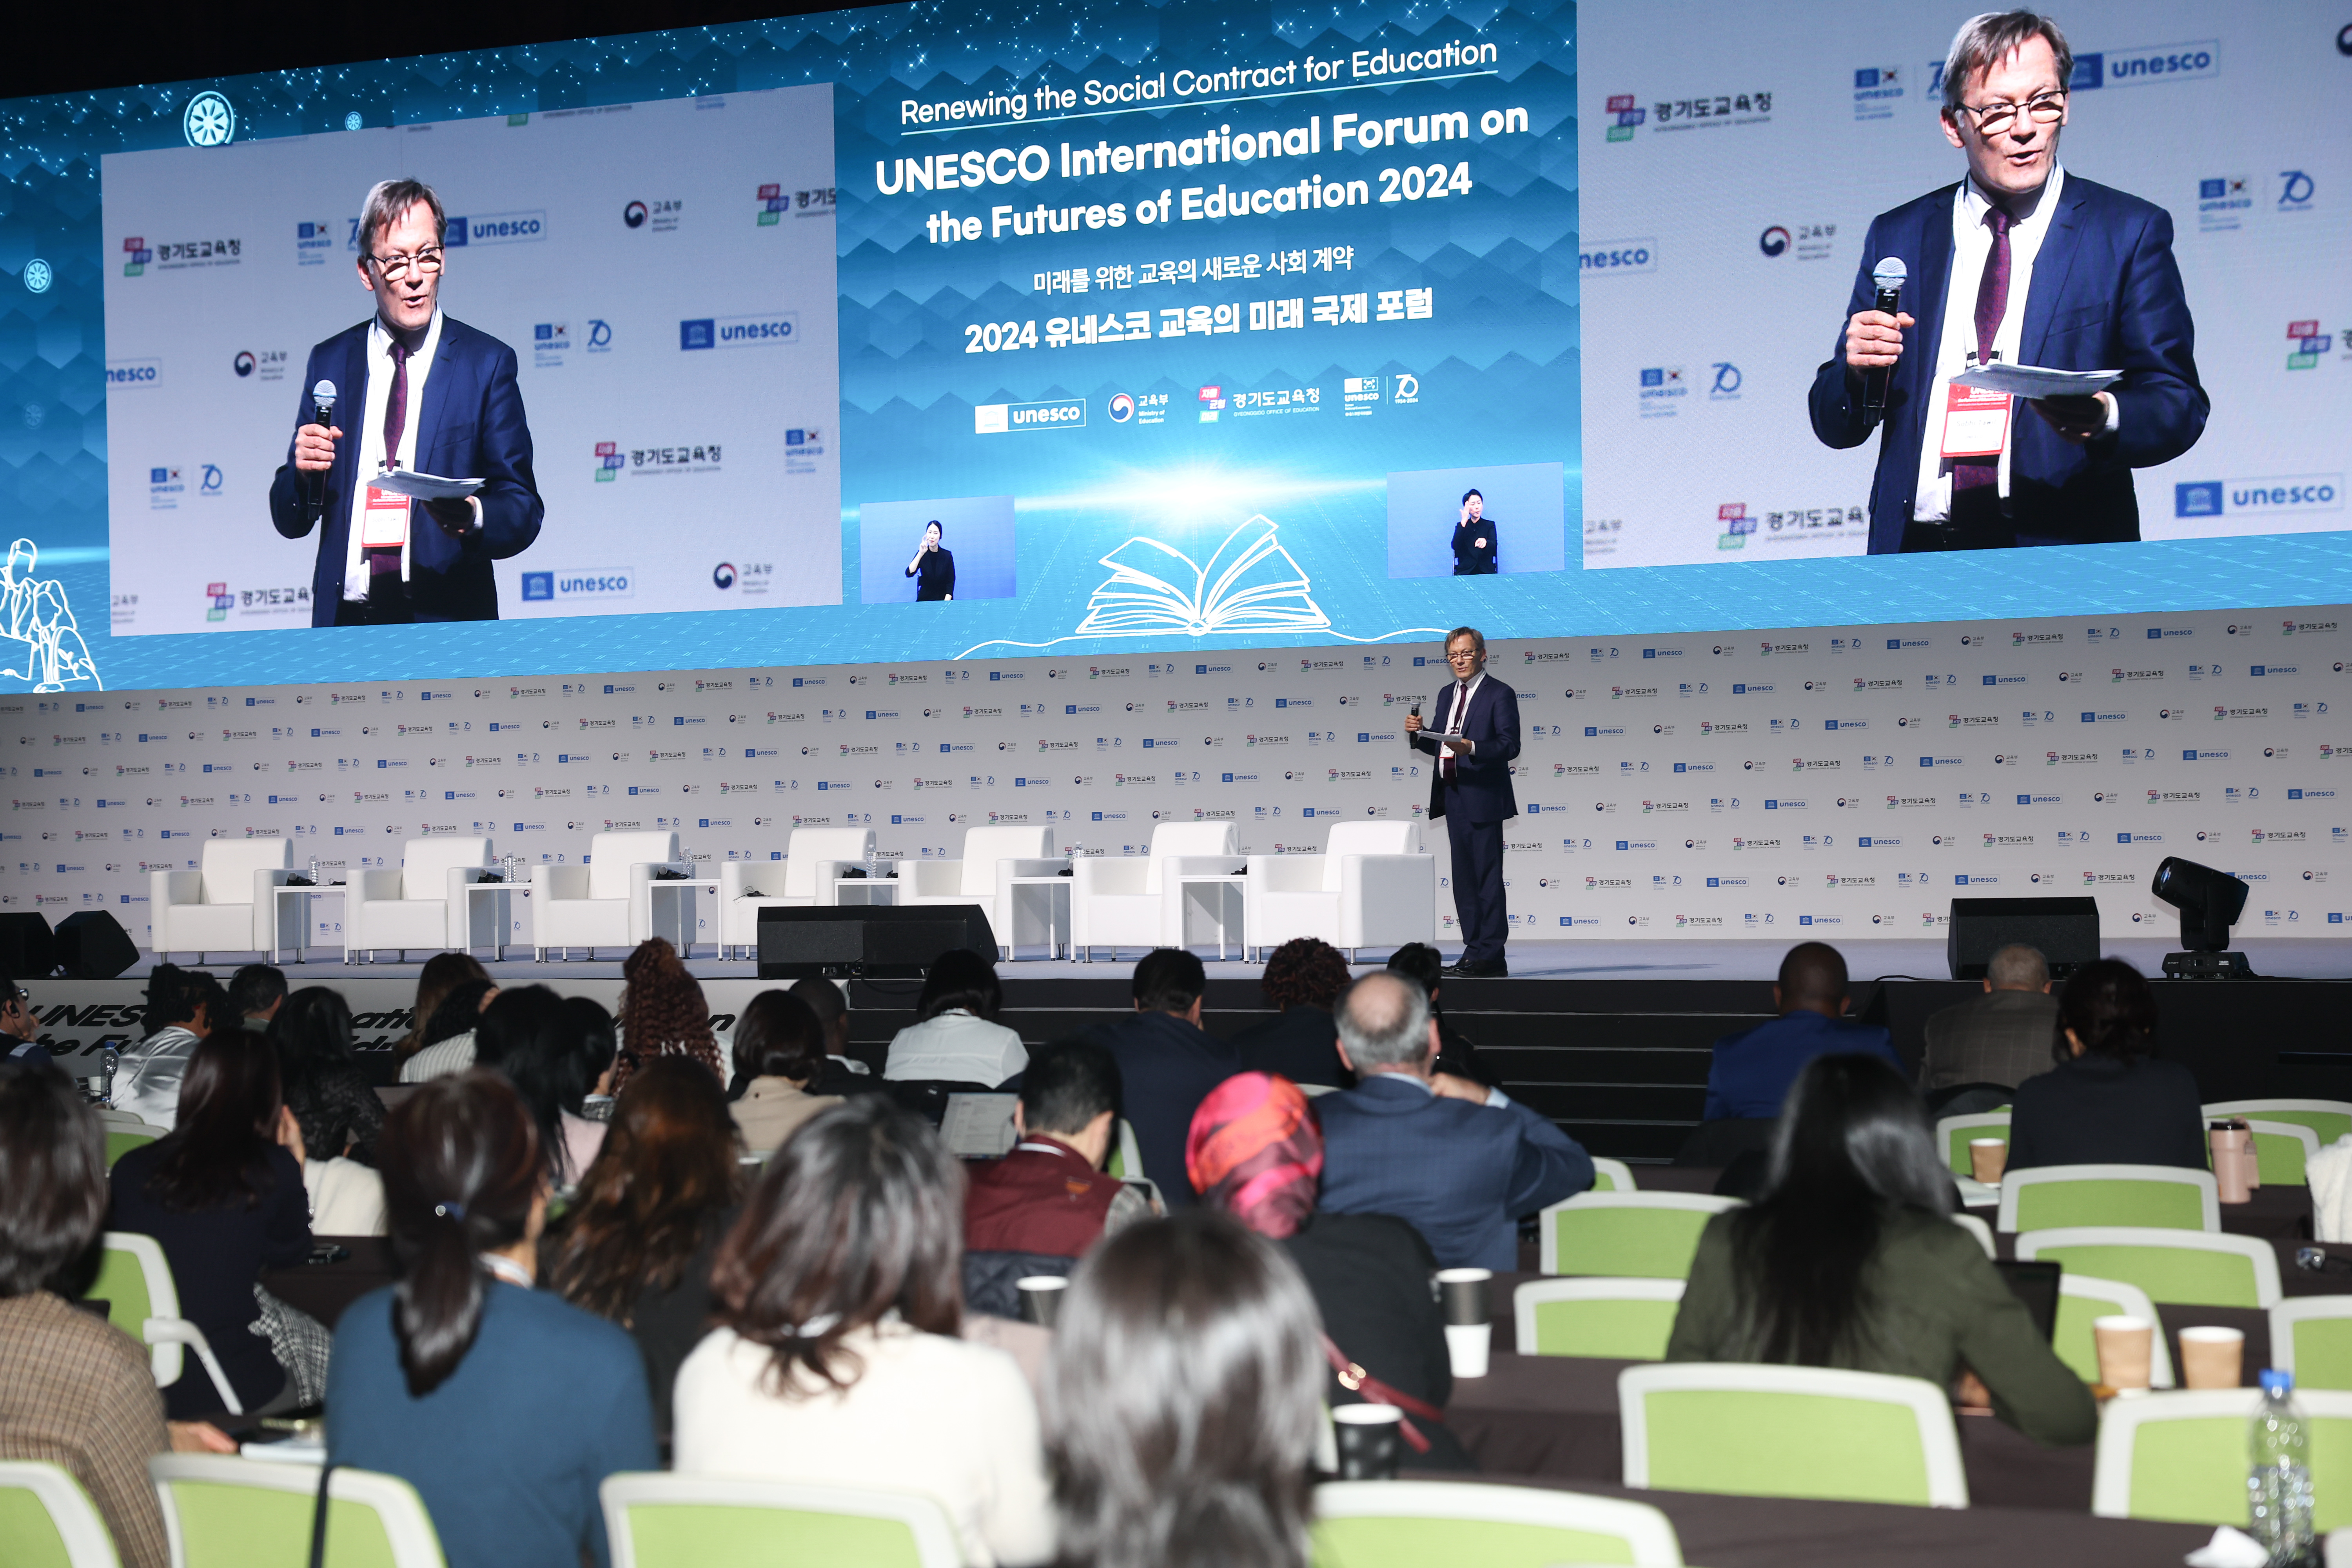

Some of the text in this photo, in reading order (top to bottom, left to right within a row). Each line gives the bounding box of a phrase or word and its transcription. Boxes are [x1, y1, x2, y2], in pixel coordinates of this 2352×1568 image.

[2112, 52, 2210, 78] unesco
[902, 40, 1496, 124] Renewing the Social Contract for Education
[1655, 93, 1771, 122] 경기도교육청
[877, 107, 1528, 194] UNESCO International Forum on
[926, 162, 1472, 243] the Futures of Education 2024
[474, 220, 540, 238] unesco
[159, 240, 240, 261] 경기도교육청
[1579, 247, 1648, 270] nesco
[1034, 245, 1354, 295] 미래를 위한 교육의 새로운 사회 계약
[721, 322, 791, 340] unesco
[965, 288, 1432, 353] 2024 유네스코 교육의 미래 국제 포럼
[106, 365, 156, 383] nesco
[1139, 394, 1168, 406] 교육부
[1233, 388, 1319, 408] 경기도교육청
[1345, 393, 1379, 401] unesco
[1014, 407, 1080, 423] unesco
[632, 446, 721, 466] 경기도교육청
[2233, 485, 2334, 506] unesco
[1766, 506, 1867, 530] 경기도교육
[561, 577, 627, 592] unesco
[240, 586, 313, 607] 경기도교육
